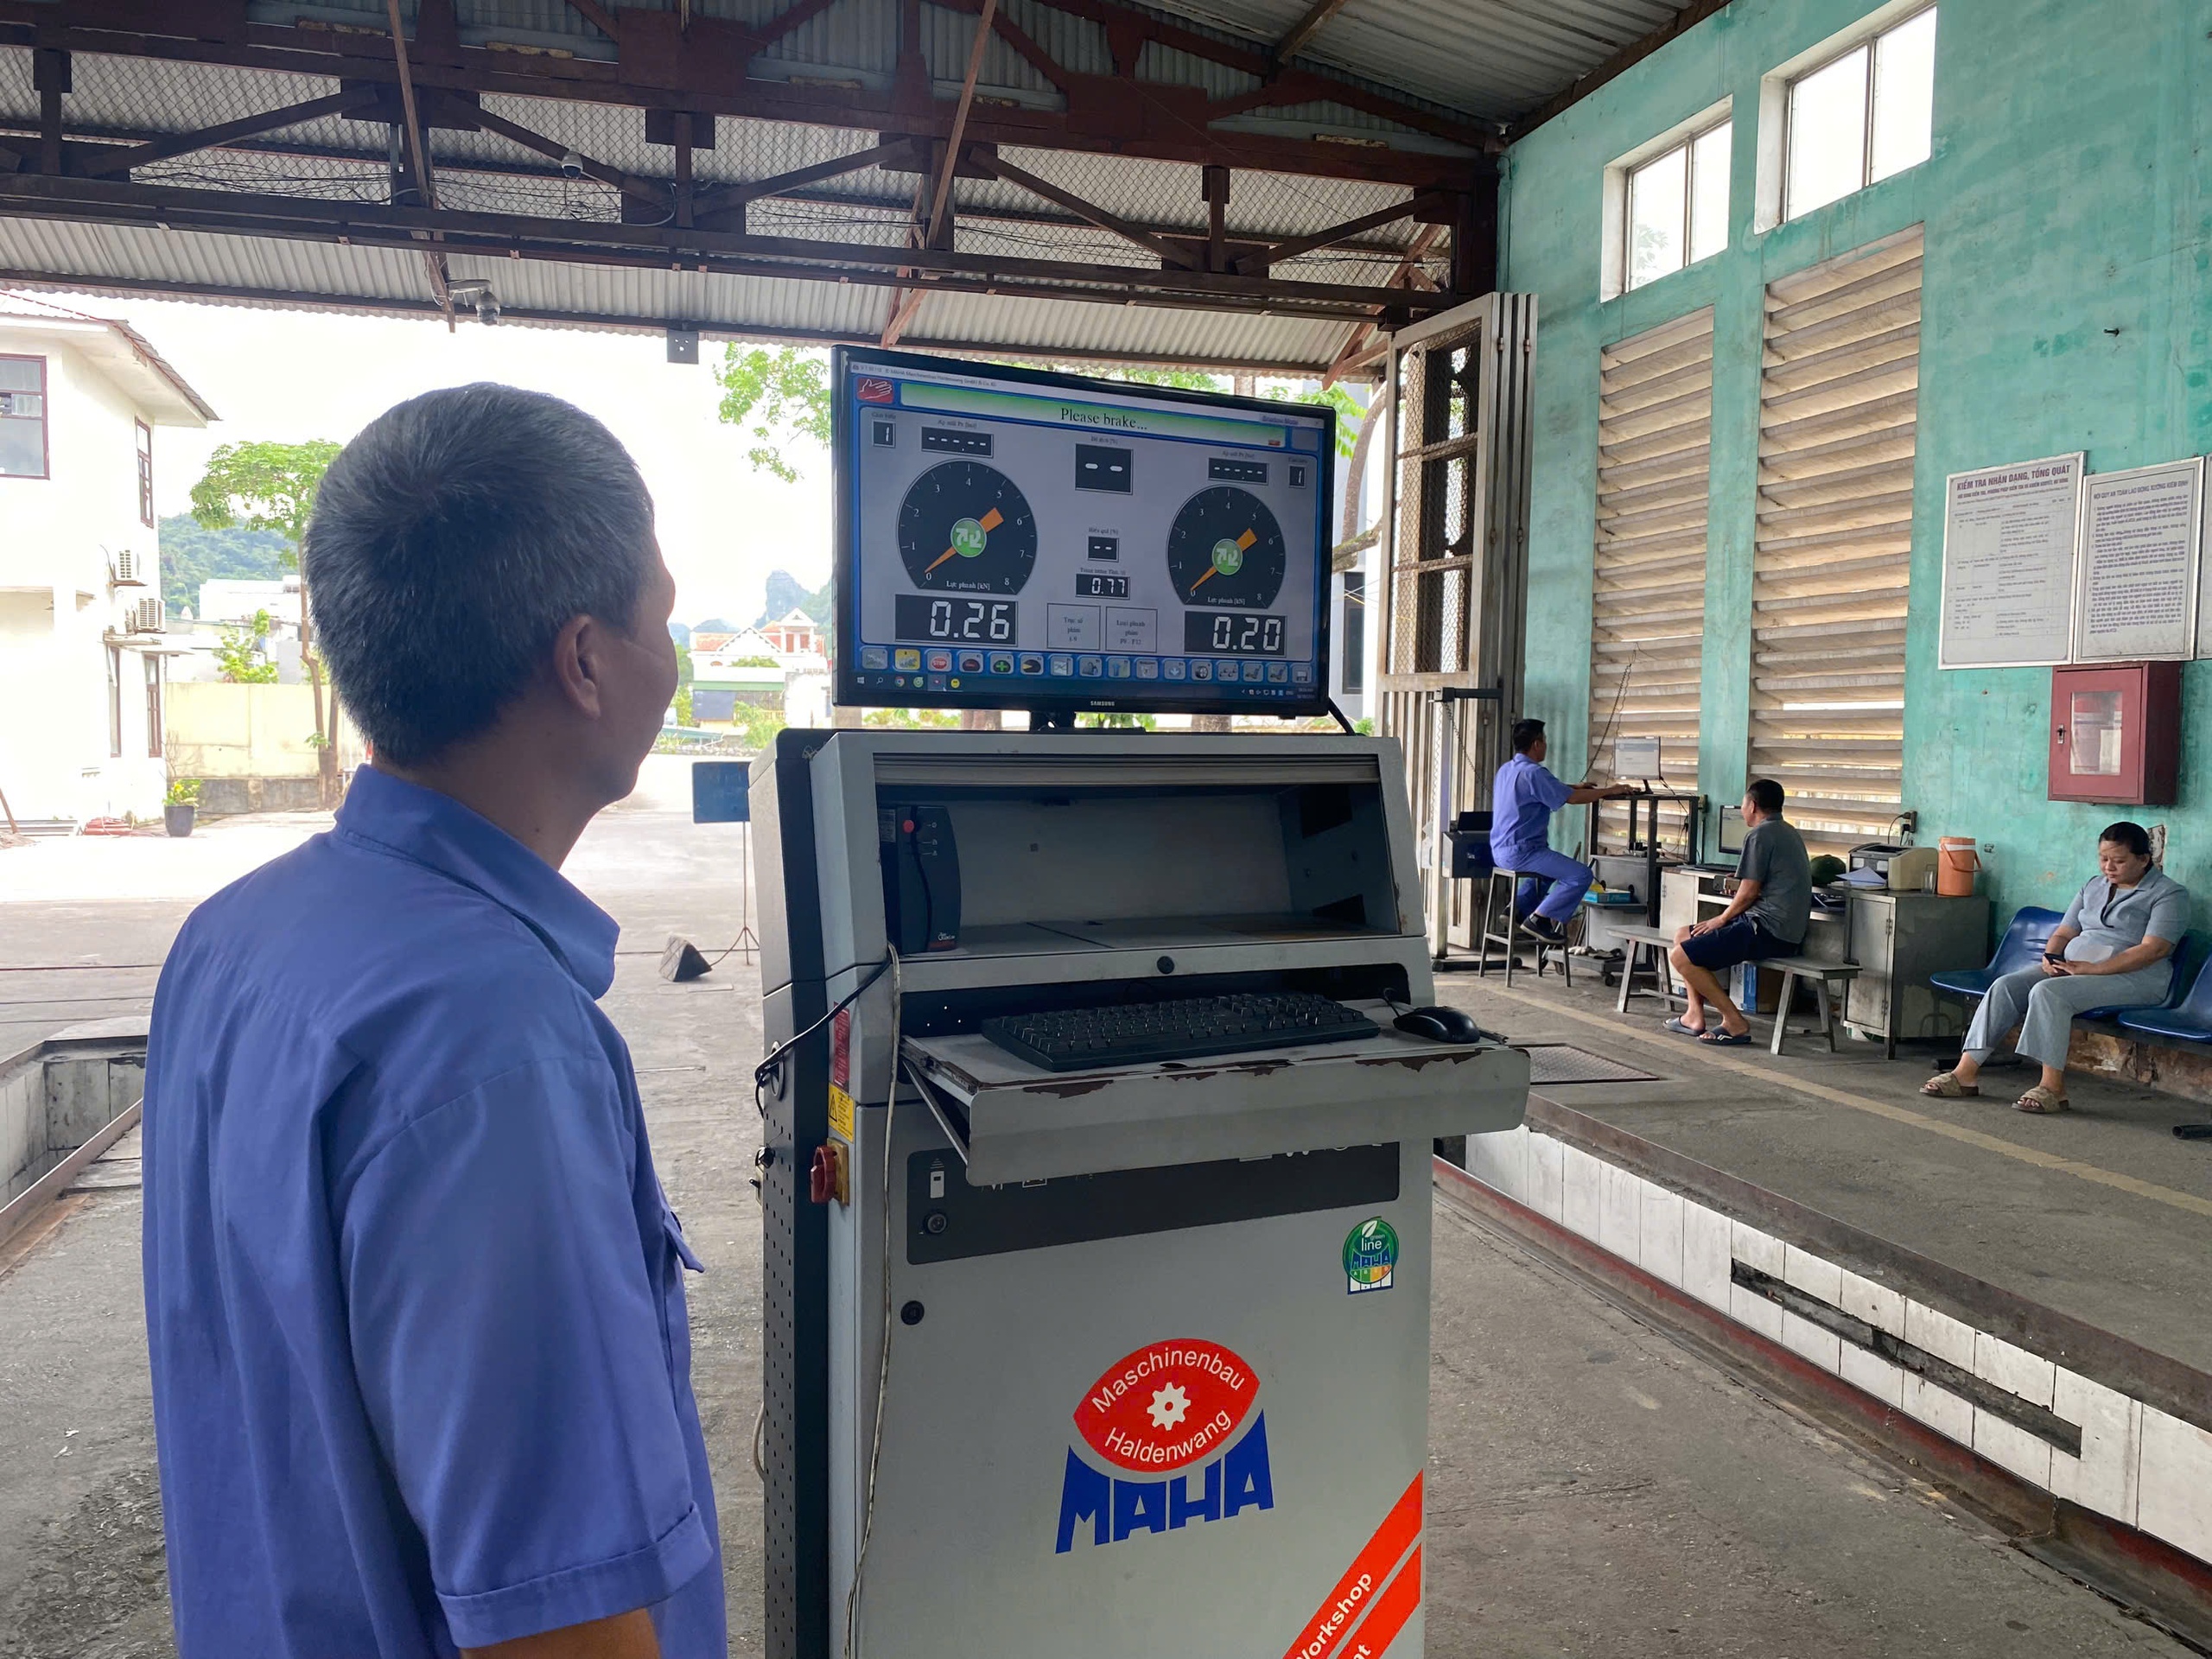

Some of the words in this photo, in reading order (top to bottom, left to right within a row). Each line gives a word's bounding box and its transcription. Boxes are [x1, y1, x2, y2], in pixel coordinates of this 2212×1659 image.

[1061, 408, 1100, 424] Please
[1103, 413, 1147, 429] brake...
[1975, 479, 1987, 488] TRA
[1092, 578, 1125, 594] 0.77
[929, 601, 1010, 639] 0.26
[1212, 616, 1282, 651] 0.20
[1361, 1237, 1382, 1252] line
[1091, 1347, 1245, 1414] Maschinenbau
[1105, 1409, 1231, 1464] Haldenwang
[1055, 1408, 1274, 1554] MAHA
